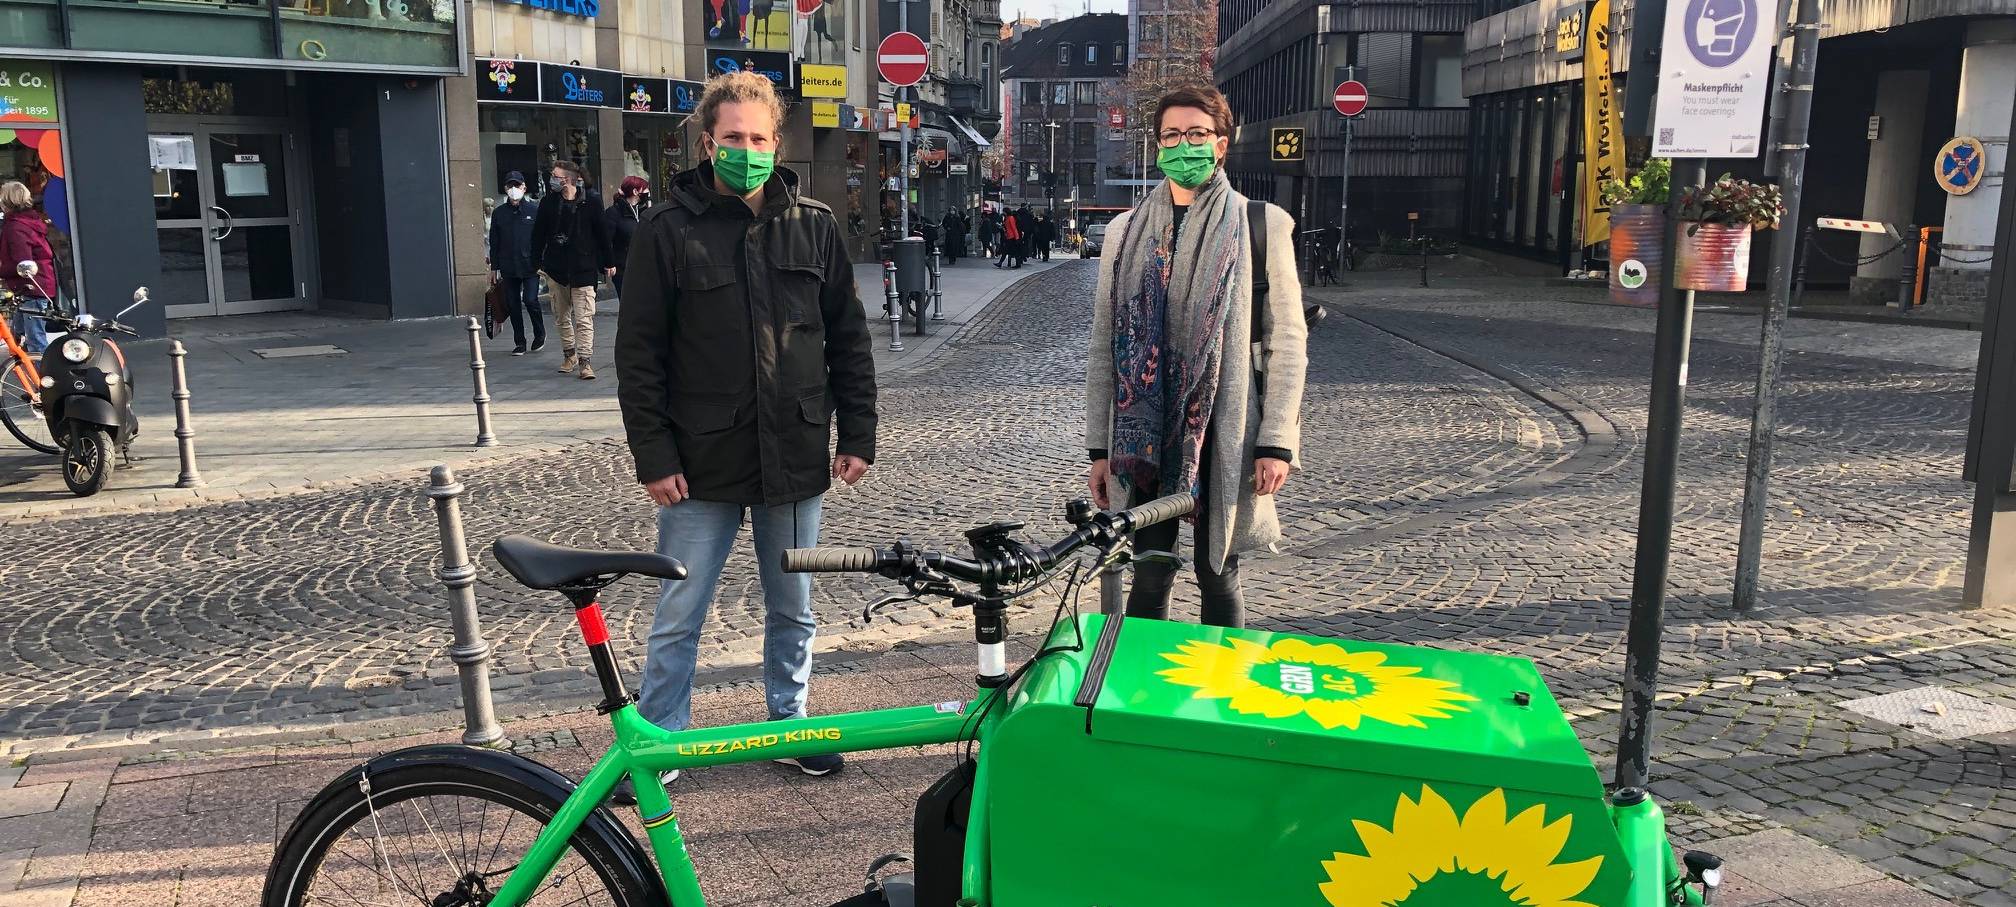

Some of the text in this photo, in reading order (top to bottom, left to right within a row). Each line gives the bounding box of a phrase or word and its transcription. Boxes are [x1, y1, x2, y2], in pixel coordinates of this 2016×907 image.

[0, 71, 47, 88] & Co.
[801, 77, 843, 87] deiters.de
[1684, 82, 1744, 95] Maskenpflicht
[4, 95, 19, 104] für
[384, 90, 390, 100] 1
[1682, 96, 1740, 105] You must wear
[25, 106, 49, 115] 1895
[1682, 106, 1736, 118] face coverings
[1279, 663, 1314, 694] GRN
[1321, 673, 1358, 695] AC
[678, 728, 842, 756] LIZZARD KING
